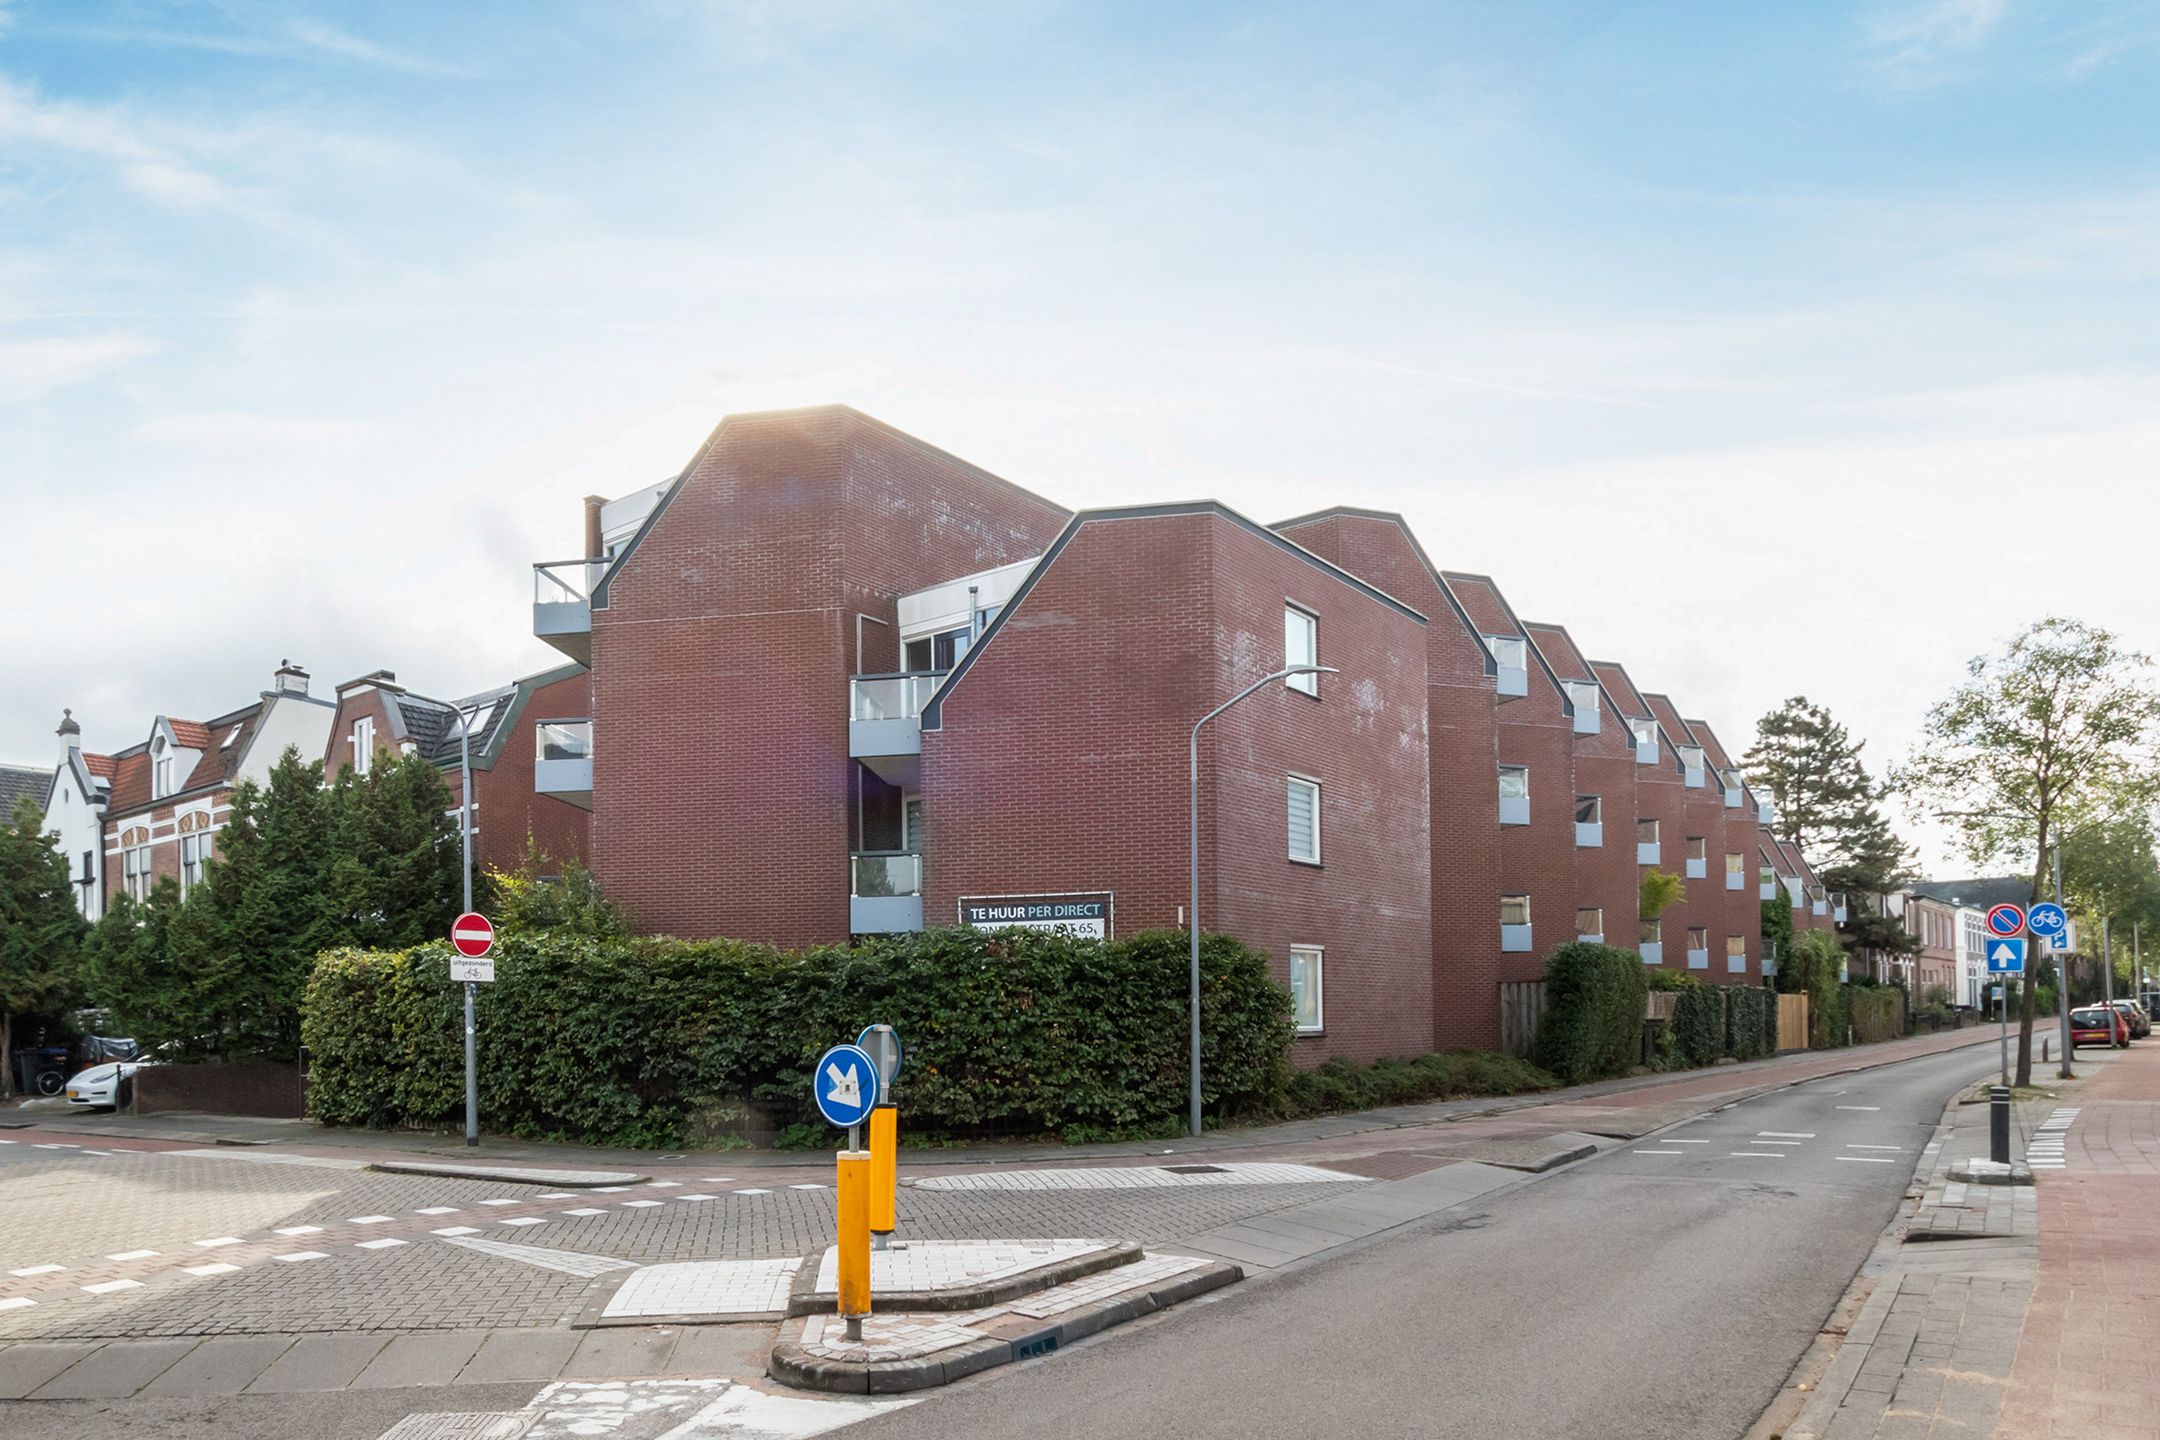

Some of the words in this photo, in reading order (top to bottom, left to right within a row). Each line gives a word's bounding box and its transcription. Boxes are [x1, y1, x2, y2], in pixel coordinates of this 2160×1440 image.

[970, 908, 986, 919] TE
[988, 907, 1025, 919] HUUR
[1028, 906, 1051, 917] PER
[1054, 904, 1101, 917] DIRECT
